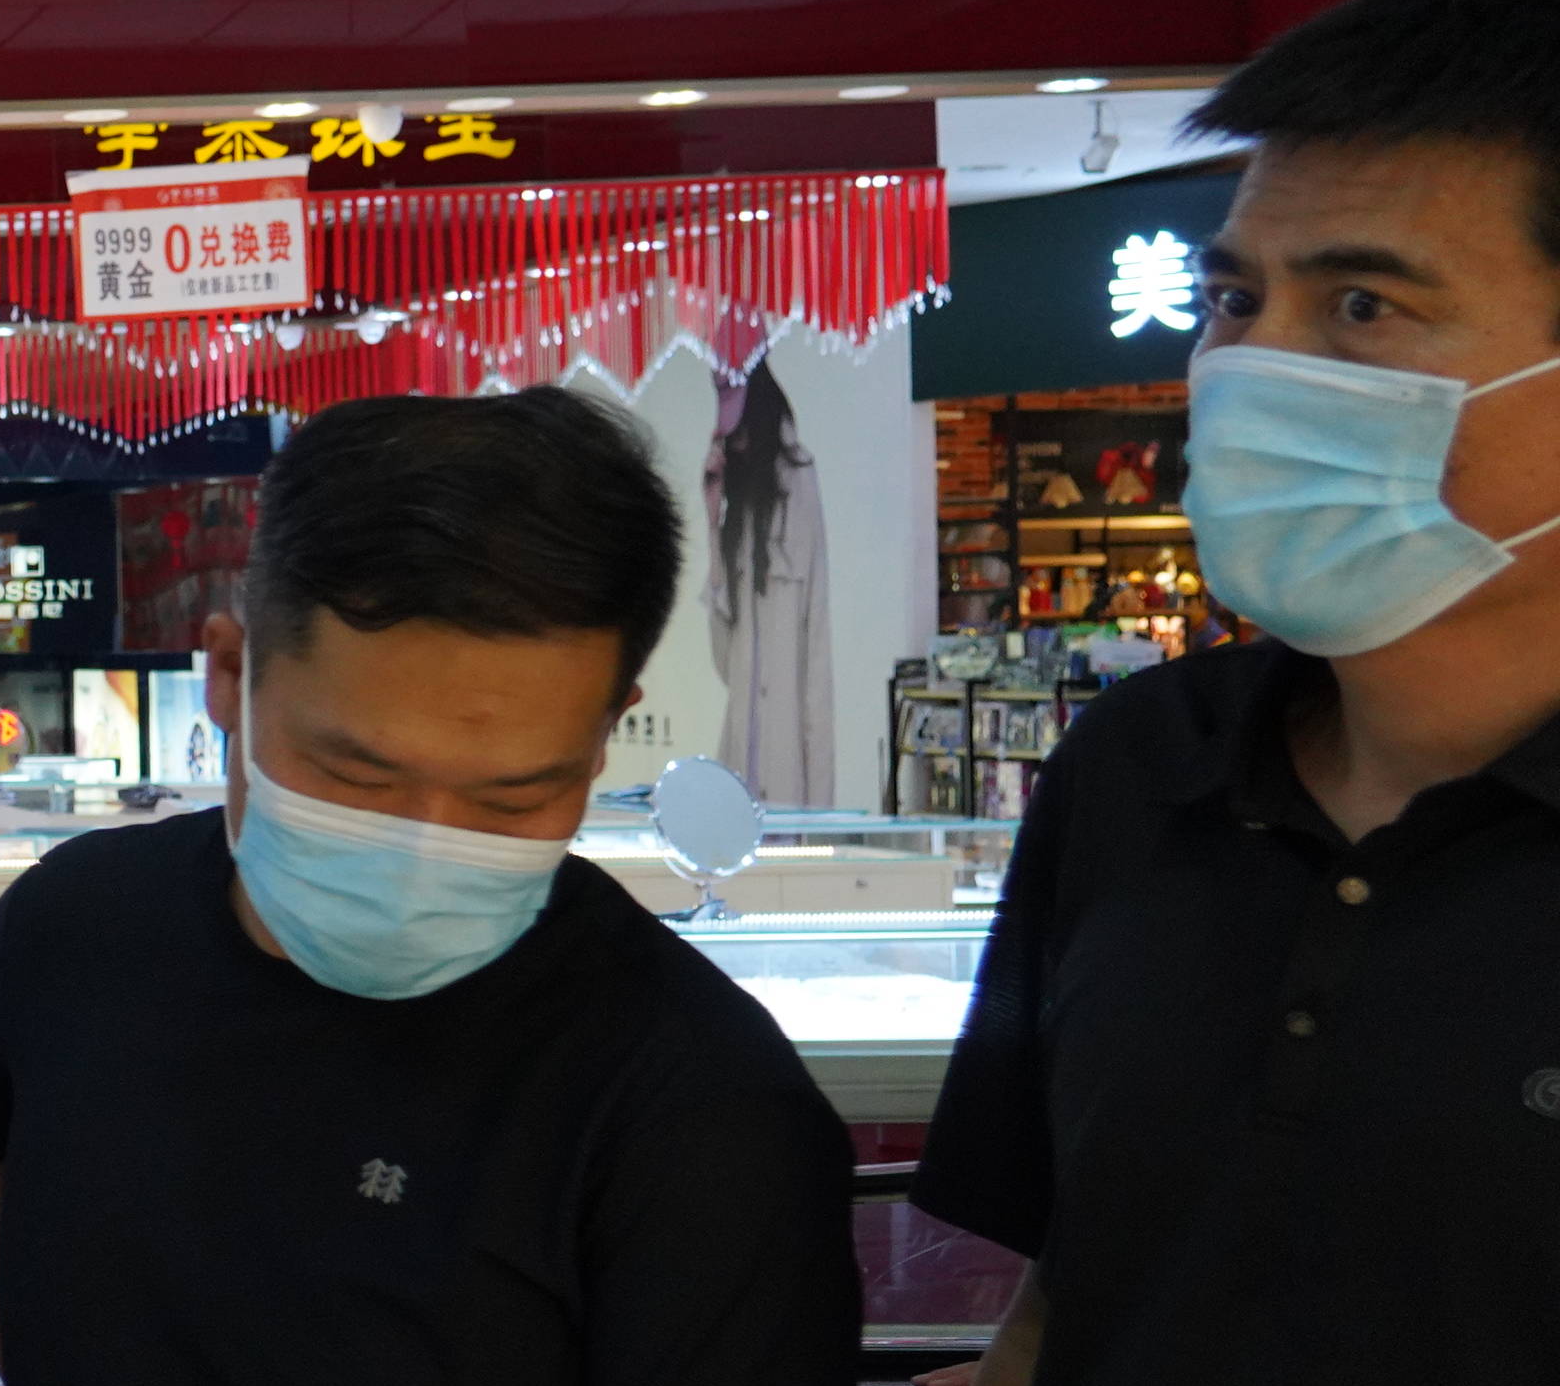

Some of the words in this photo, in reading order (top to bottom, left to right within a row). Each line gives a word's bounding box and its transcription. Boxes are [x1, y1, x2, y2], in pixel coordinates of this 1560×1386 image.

[94, 226, 153, 255] 9999
[96, 259, 154, 301] 黄金
[1108, 230, 1197, 339] 美
